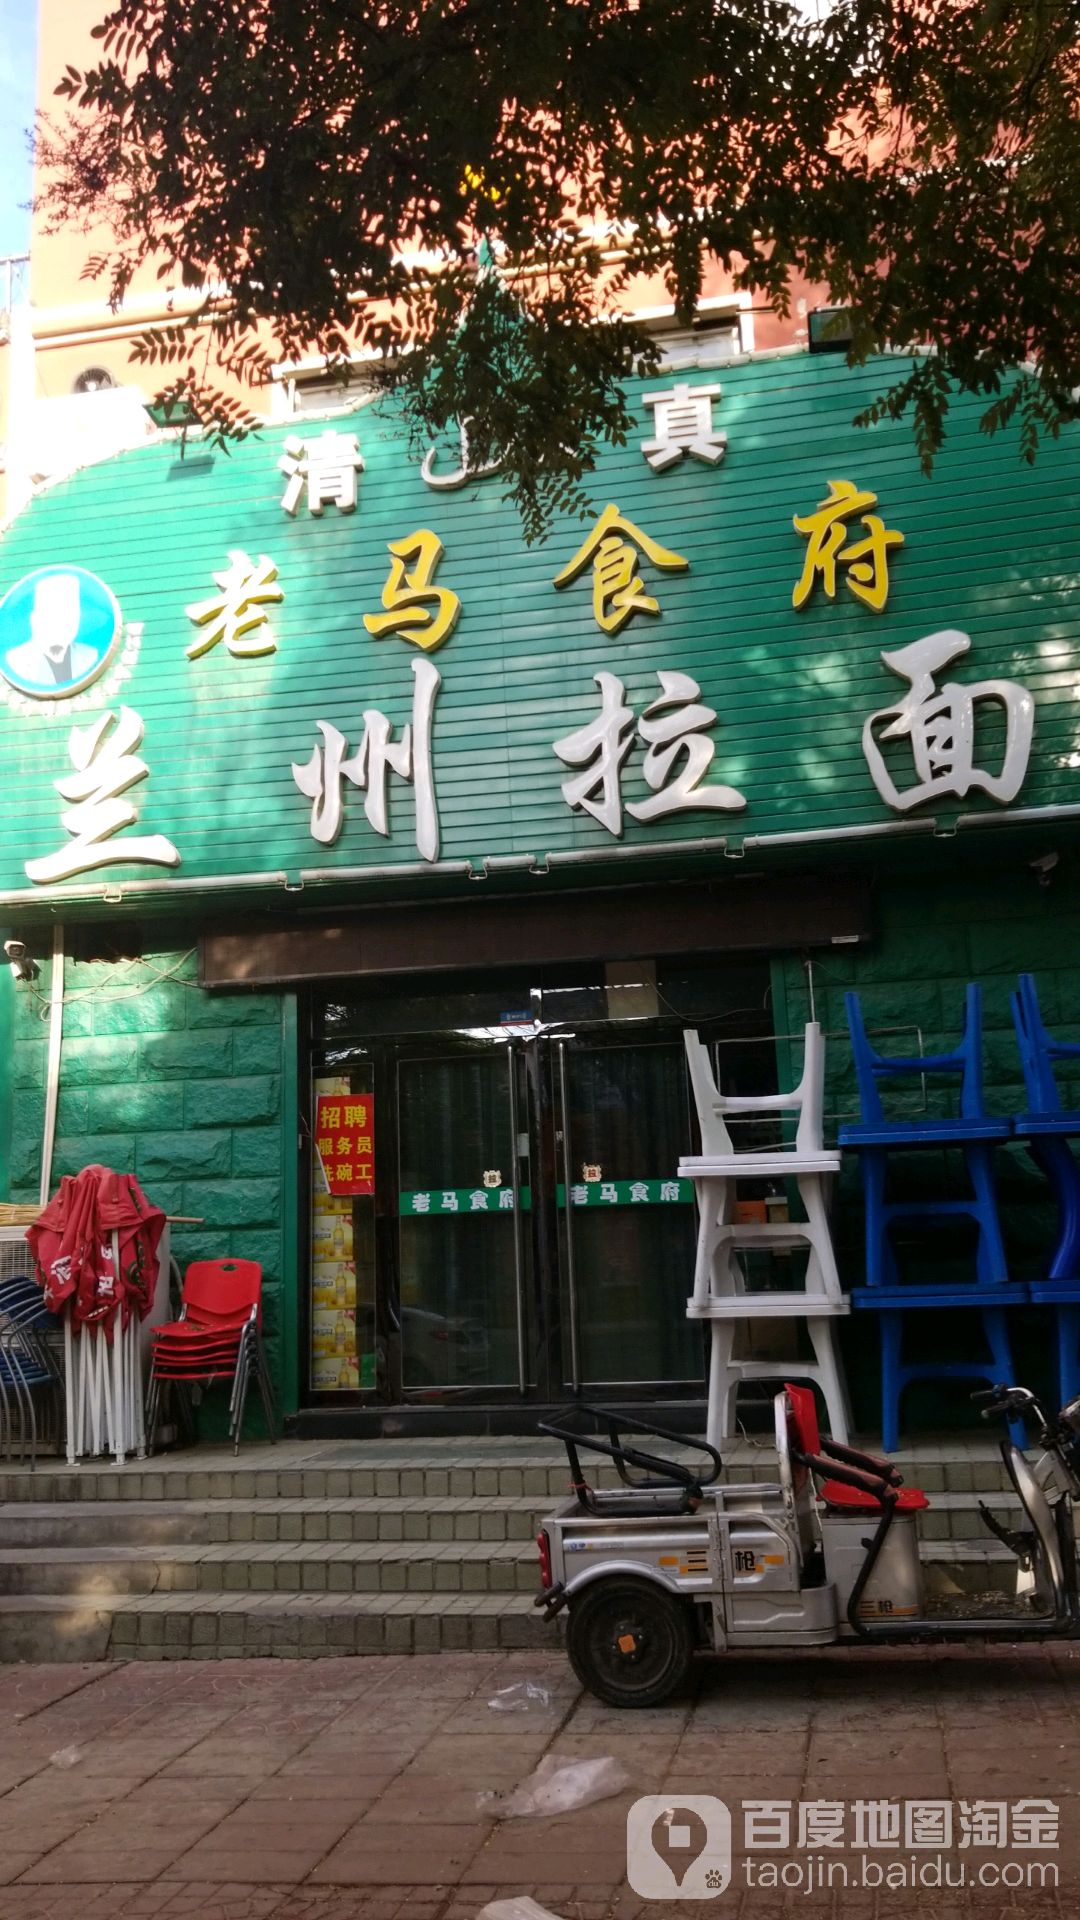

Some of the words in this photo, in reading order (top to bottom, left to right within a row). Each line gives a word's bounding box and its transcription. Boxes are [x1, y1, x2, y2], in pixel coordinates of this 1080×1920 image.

[185, 479, 905, 660] 老马食府
[24, 629, 1035, 884] 兰州拉面
[320, 1105, 367, 1129] 招聘
[318, 1136, 372, 1156] 服务员
[570, 1182, 680, 1205] 老马食府
